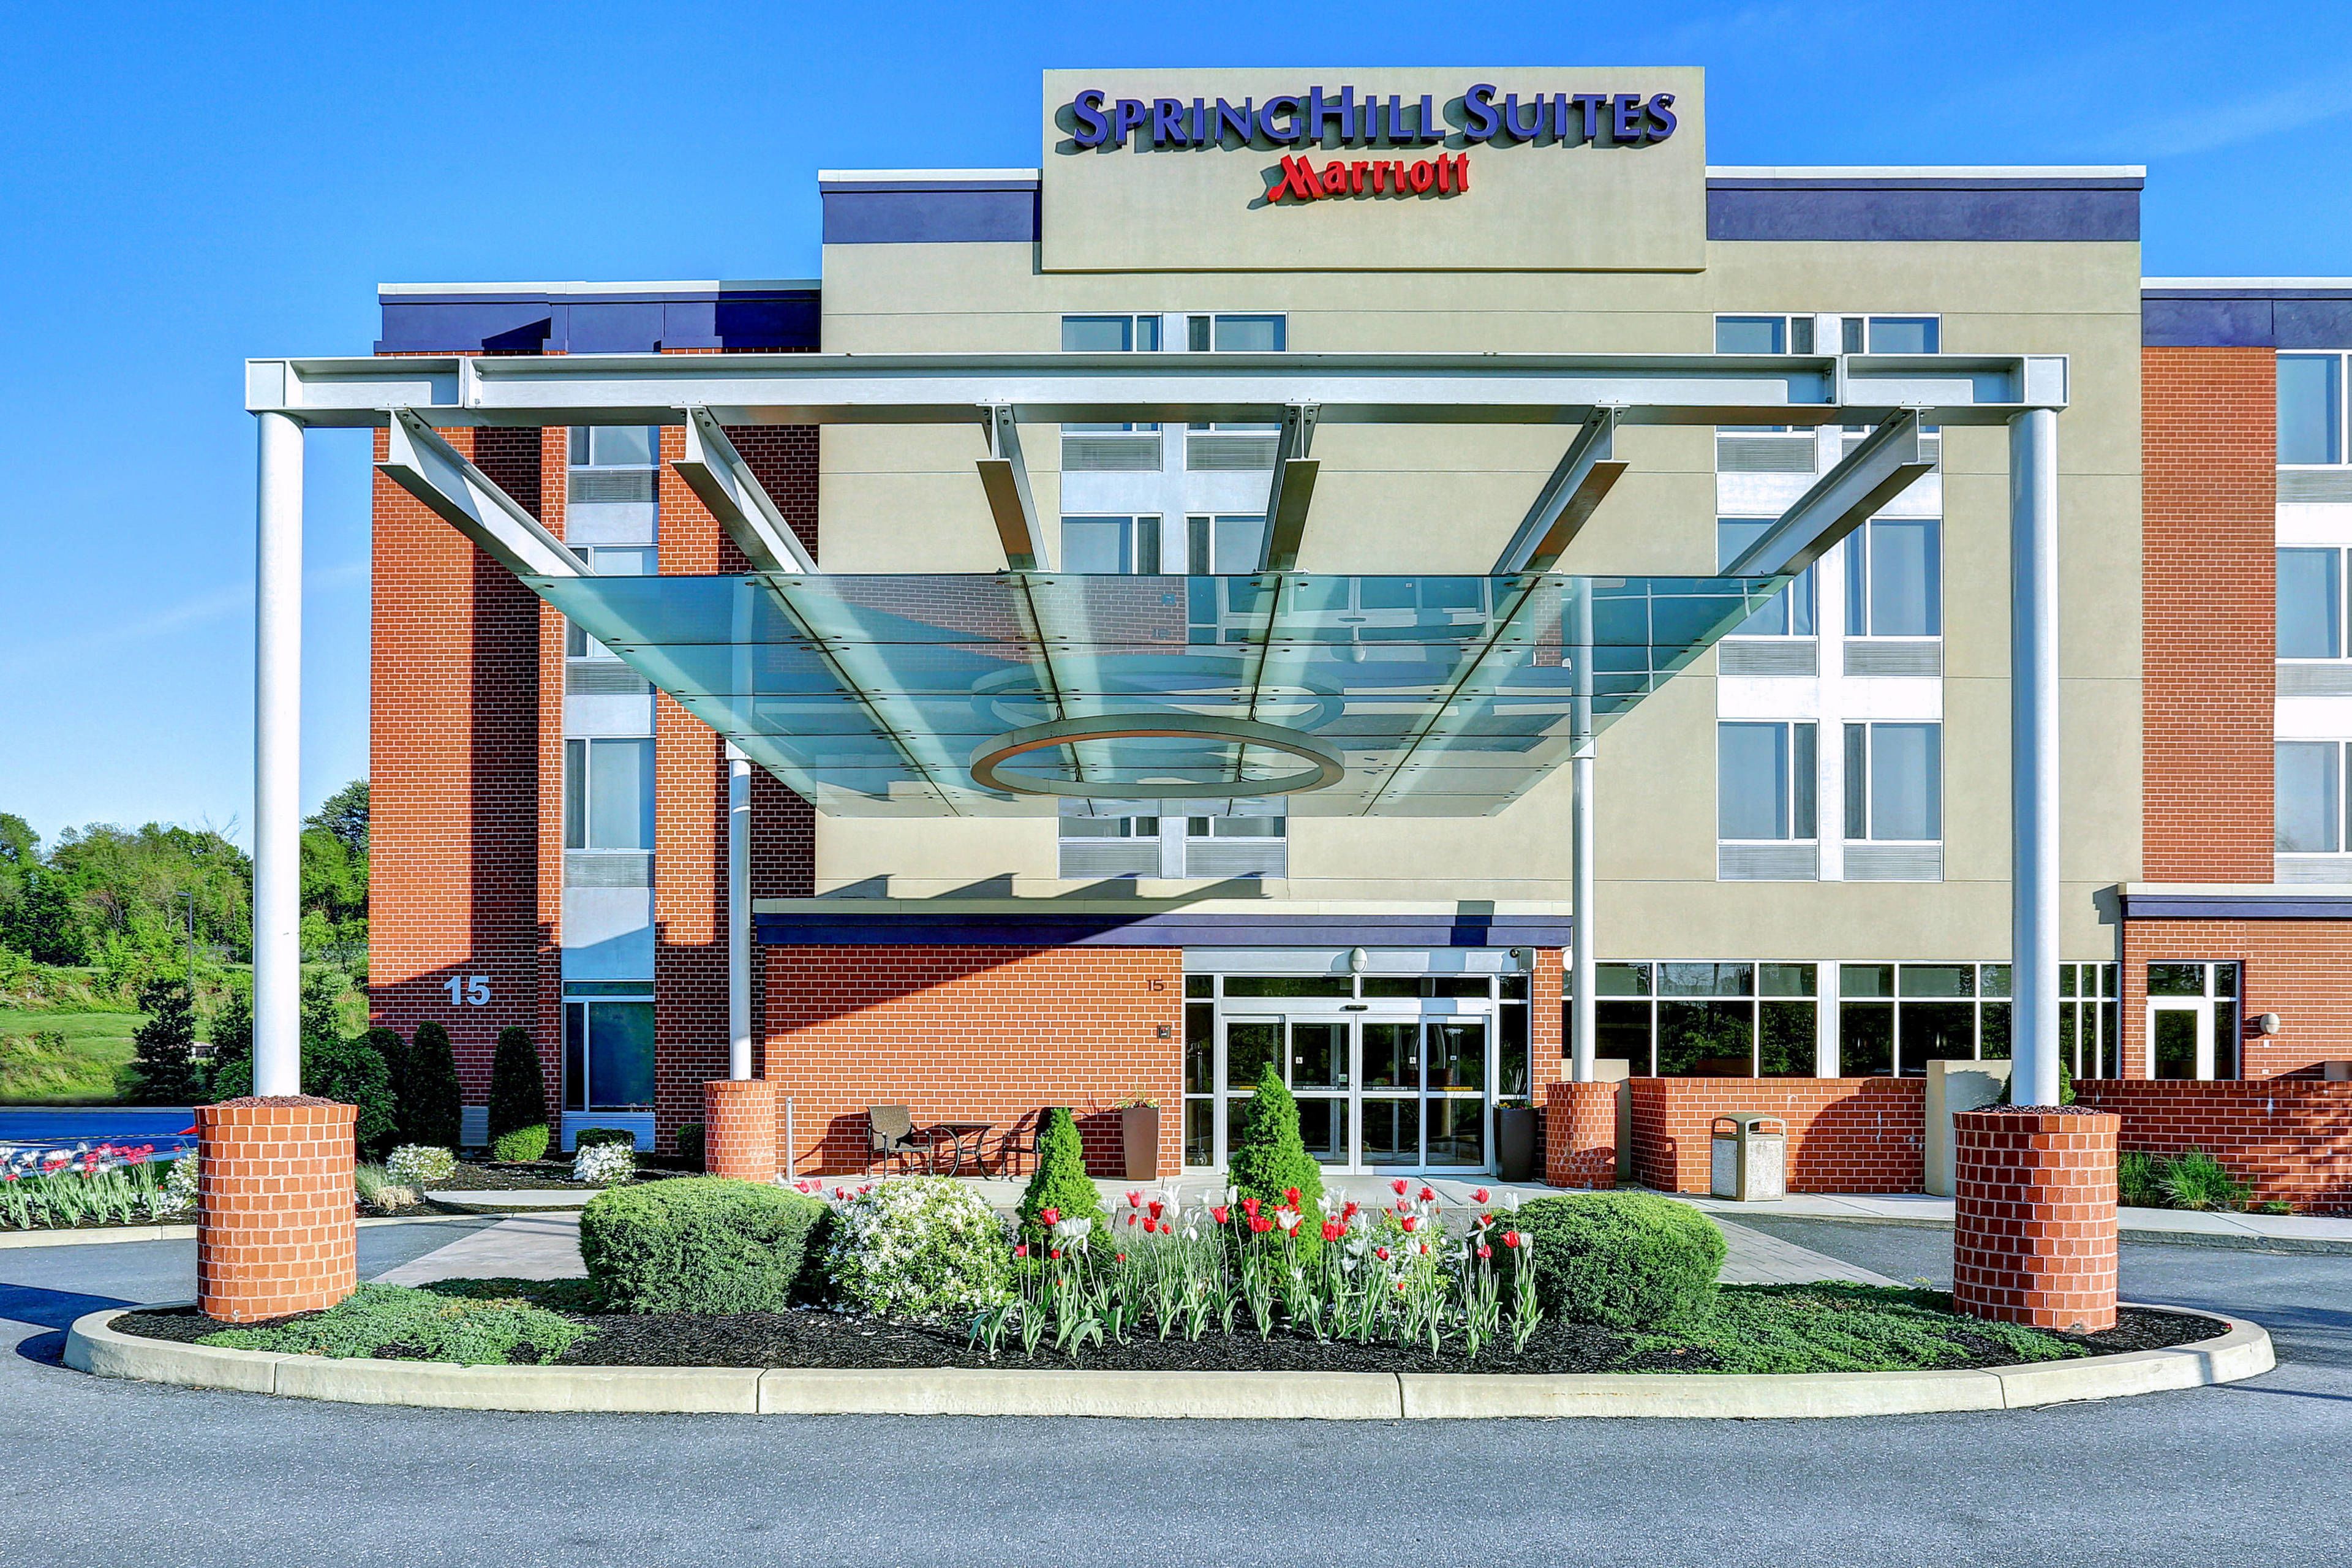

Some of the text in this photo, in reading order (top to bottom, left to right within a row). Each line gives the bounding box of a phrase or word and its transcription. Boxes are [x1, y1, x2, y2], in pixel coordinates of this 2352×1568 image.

[1073, 83, 1677, 148] SPRINGHILL SUITES
[1267, 151, 1470, 202] Marriott
[443, 975, 491, 1006] 15
[1147, 979, 1164, 991] 15
